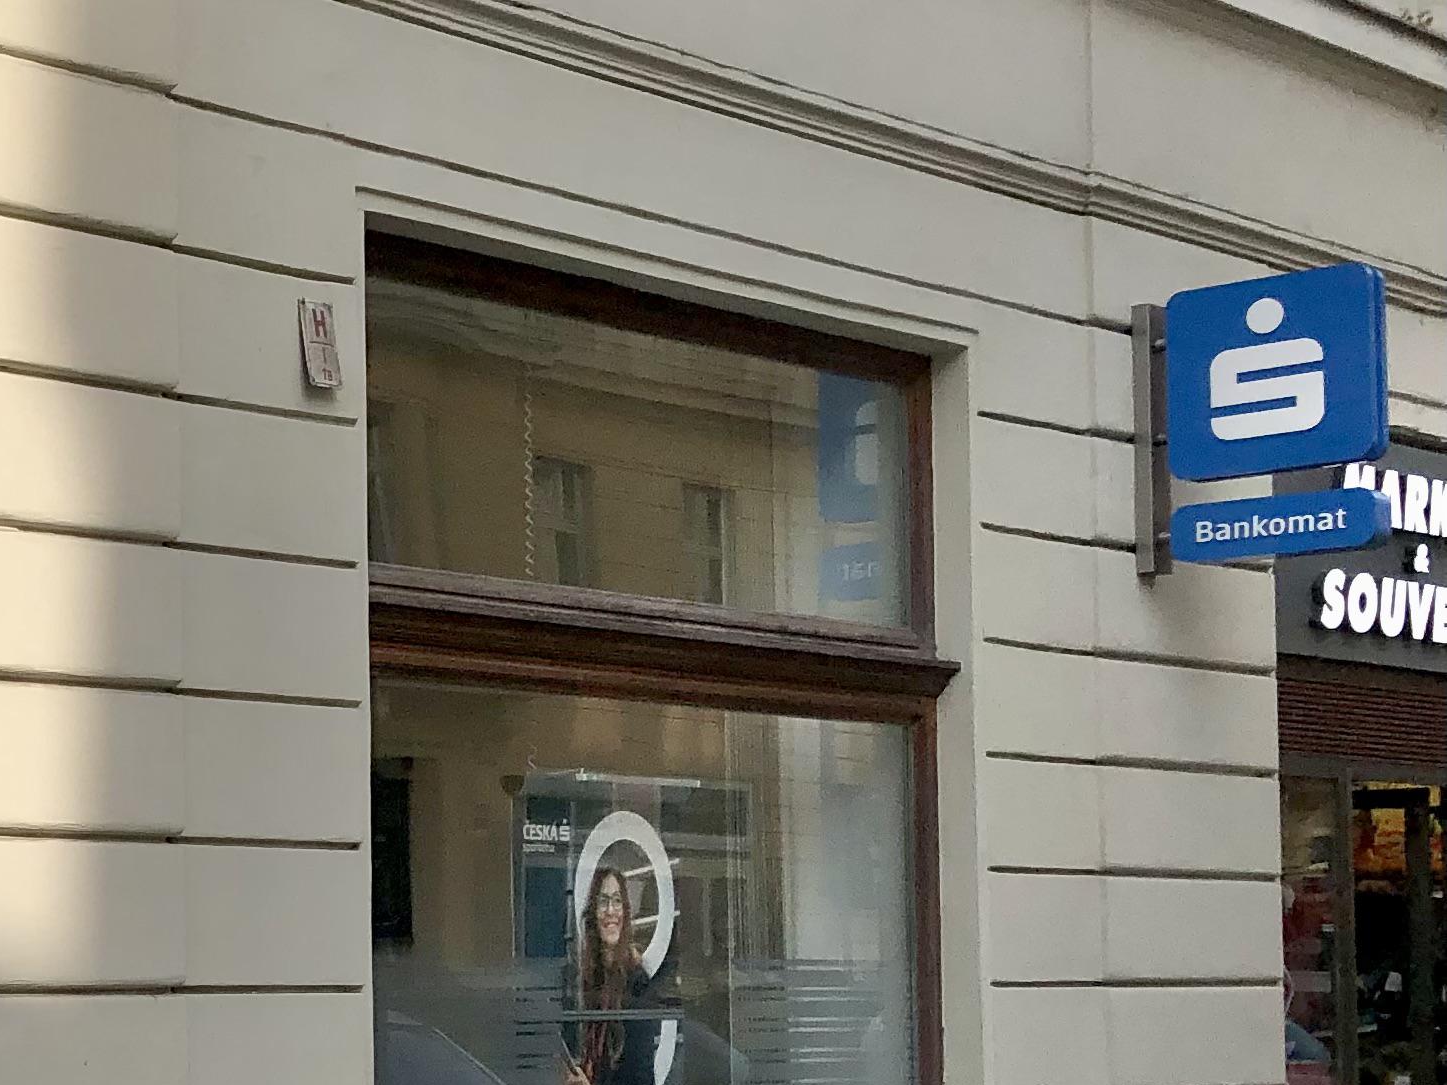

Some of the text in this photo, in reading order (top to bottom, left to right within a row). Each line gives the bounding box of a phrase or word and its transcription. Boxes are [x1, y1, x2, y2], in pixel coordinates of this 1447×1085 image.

[311, 308, 328, 339] H
[1195, 508, 1347, 543] Bankomat
[1414, 543, 1430, 574] &
